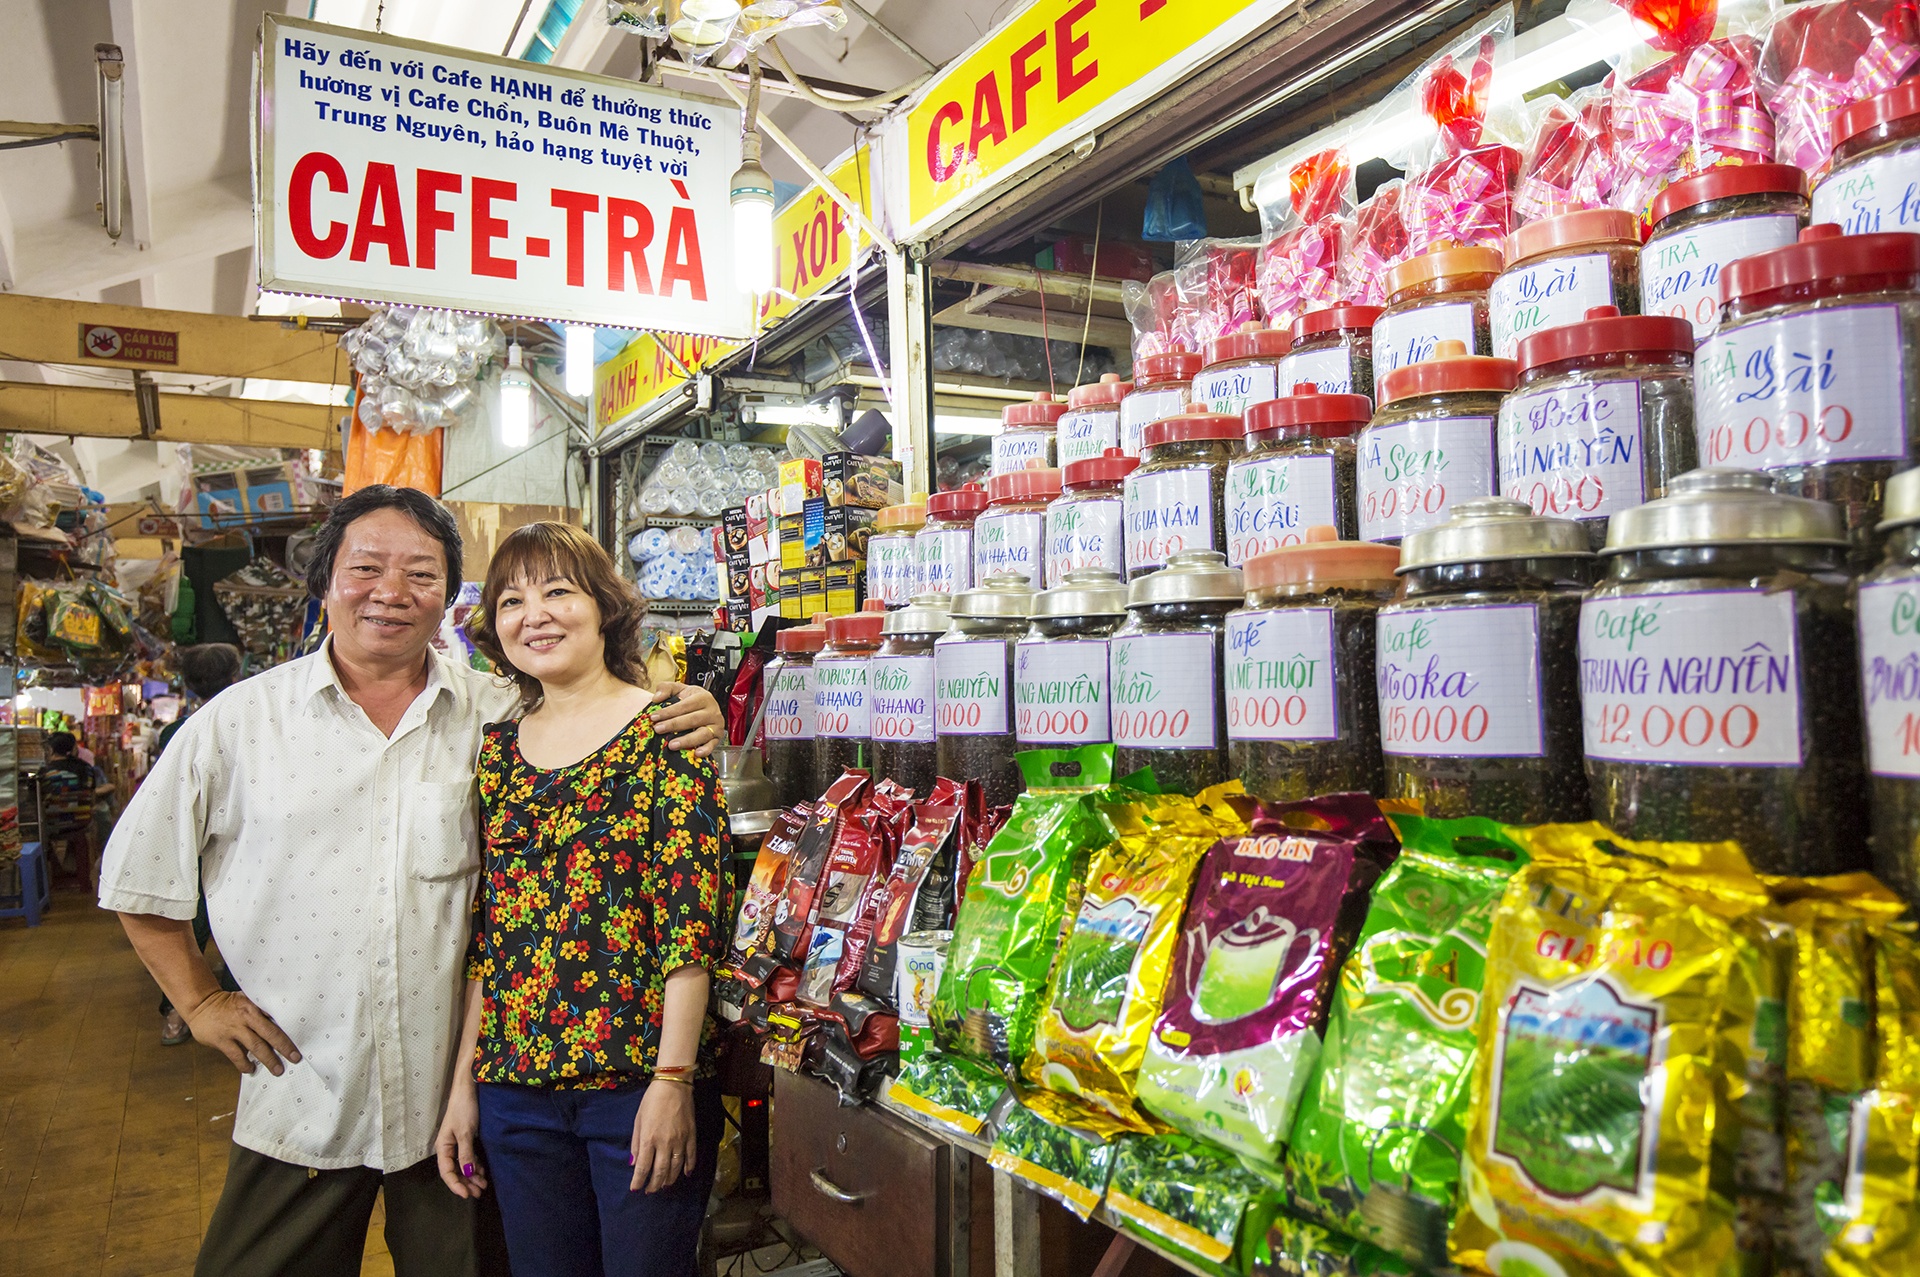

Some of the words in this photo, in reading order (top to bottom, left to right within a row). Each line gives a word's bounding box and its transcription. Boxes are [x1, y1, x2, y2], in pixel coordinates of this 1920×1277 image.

[284, 38, 330, 66] Hãy
[339, 46, 381, 73] đến
[390, 57, 424, 81] với
[432, 65, 482, 90] Cafe
[490, 75, 553, 103] HẠNH
[560, 87, 588, 107] để
[592, 93, 662, 124] thưởng
[668, 107, 712, 131] thức
[299, 70, 373, 101] hương
[381, 84, 401, 109] vị
[408, 90, 459, 114] Cafe
[467, 99, 530, 129] Chồn,
[538, 110, 592, 135] Buôn
[599, 119, 630, 142] Mê
[636, 127, 701, 156] Thuột,
[315, 101, 387, 132] Trung
[396, 115, 487, 149] Nguyên,
[496, 129, 535, 153] hảo
[542, 137, 594, 165] hạng
[601, 147, 653, 174] tuyệt
[658, 155, 688, 177] vời
[124, 347, 143, 358] NO
[146, 349, 174, 361] FIRE
[1383, 617, 1438, 663] Café
[1595, 601, 1662, 652] Café
[818, 667, 868, 687] ROBUSTA
[947, 670, 999, 699] NGUYÊN
[1037, 672, 1101, 705] NGUYÊN
[1582, 655, 1651, 695] TRUNG
[1659, 641, 1790, 695] NGUYÊN
[1386, 703, 1490, 744] 15.000
[1597, 703, 1760, 750] 12.000
